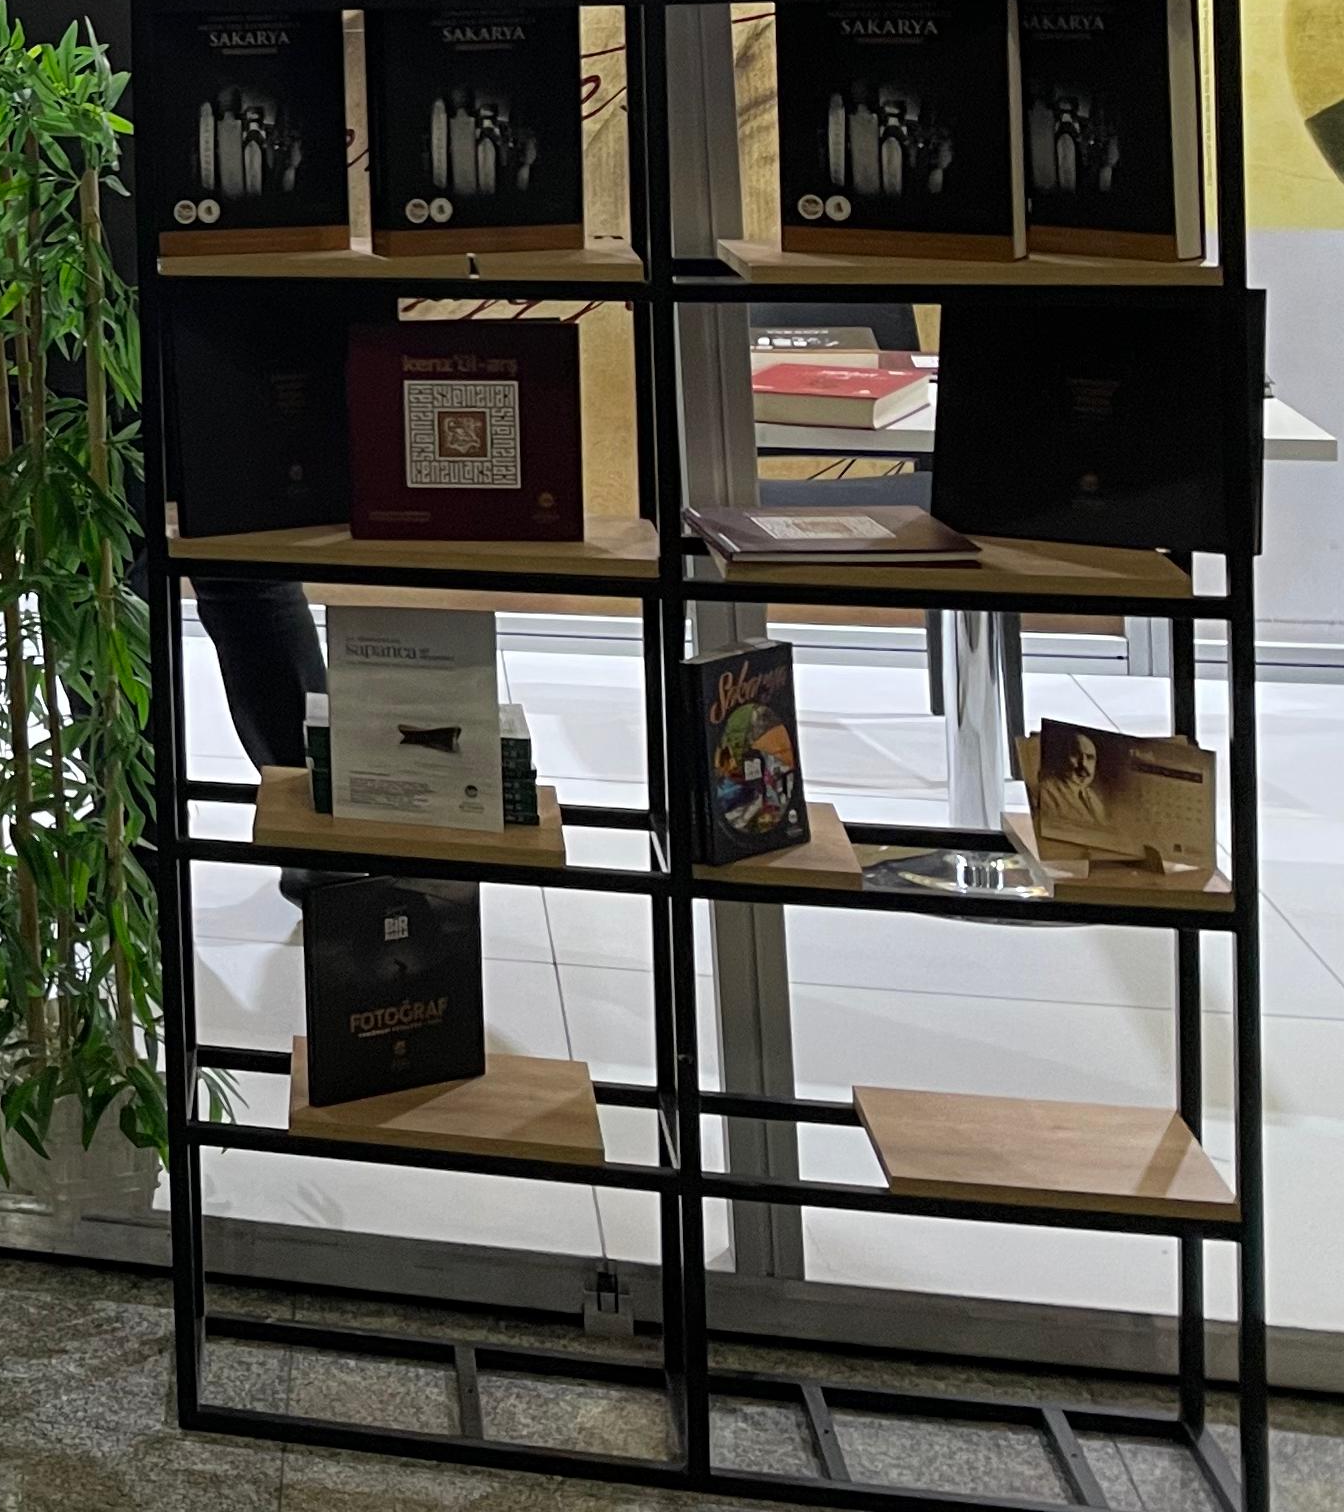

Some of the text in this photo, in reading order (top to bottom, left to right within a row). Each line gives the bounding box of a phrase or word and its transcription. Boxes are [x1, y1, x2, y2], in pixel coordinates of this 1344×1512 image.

[442, 26, 526, 43] SAKARYA
[841, 18, 939, 36] SAKARYA
[209, 30, 290, 48] SAKARYA
[350, 997, 448, 1032] FOTOĞRAF
